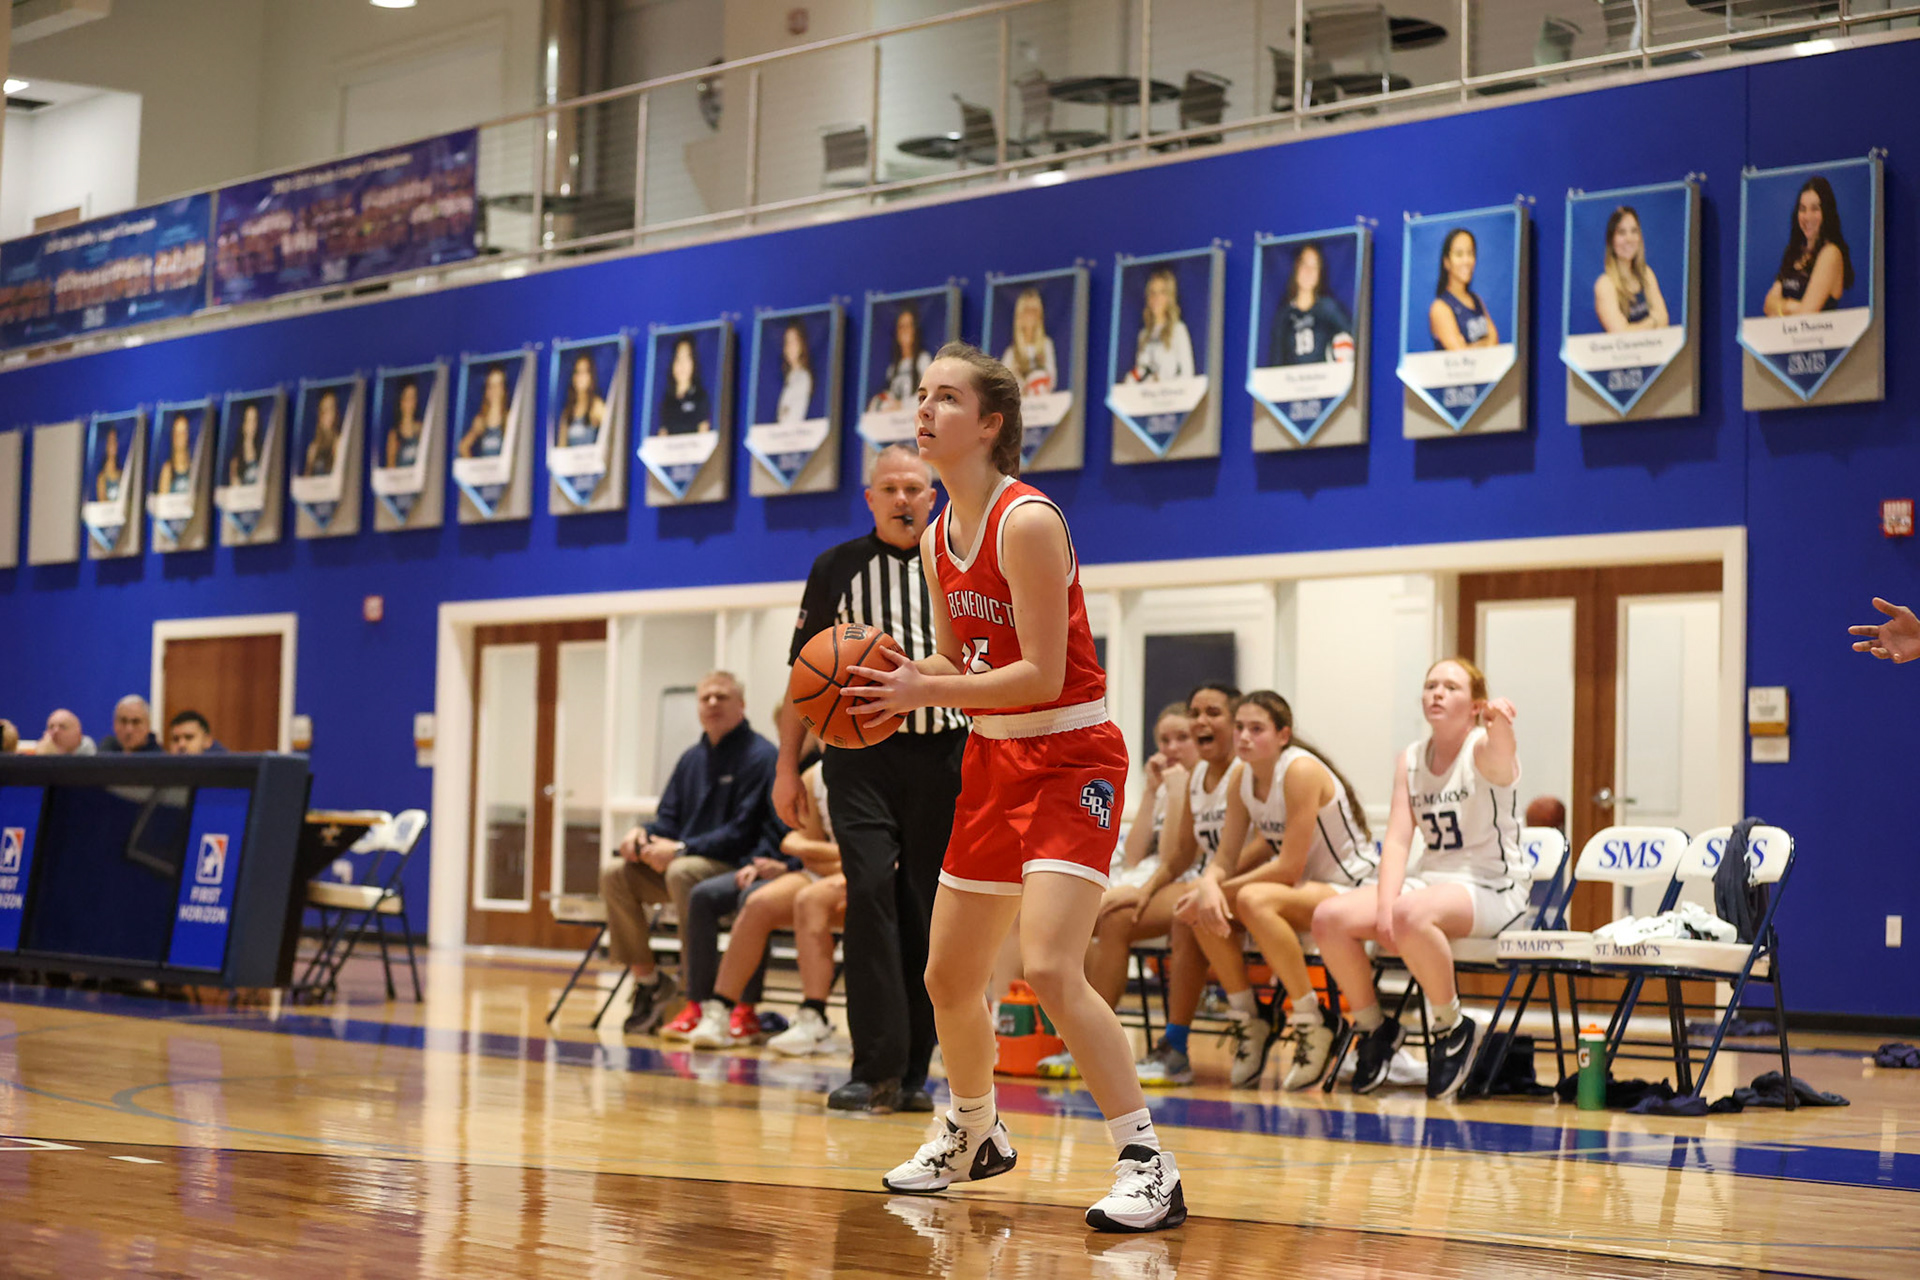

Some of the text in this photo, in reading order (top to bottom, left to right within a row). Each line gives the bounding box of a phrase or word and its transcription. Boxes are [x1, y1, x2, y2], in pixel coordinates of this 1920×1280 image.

[1788, 352, 1826, 375] SMS
[947, 590, 1015, 628] BENEDICT
[1081, 786, 1110, 828] SBA
[1422, 811, 1463, 850] 33
[1599, 840, 1664, 869] SMS
[1703, 838, 1768, 869] SS
[190, 886, 222, 903] FIRST
[179, 904, 228, 923] HORIZON
[1613, 944, 1661, 956] MARY'S
[1579, 1048, 1590, 1068] G
